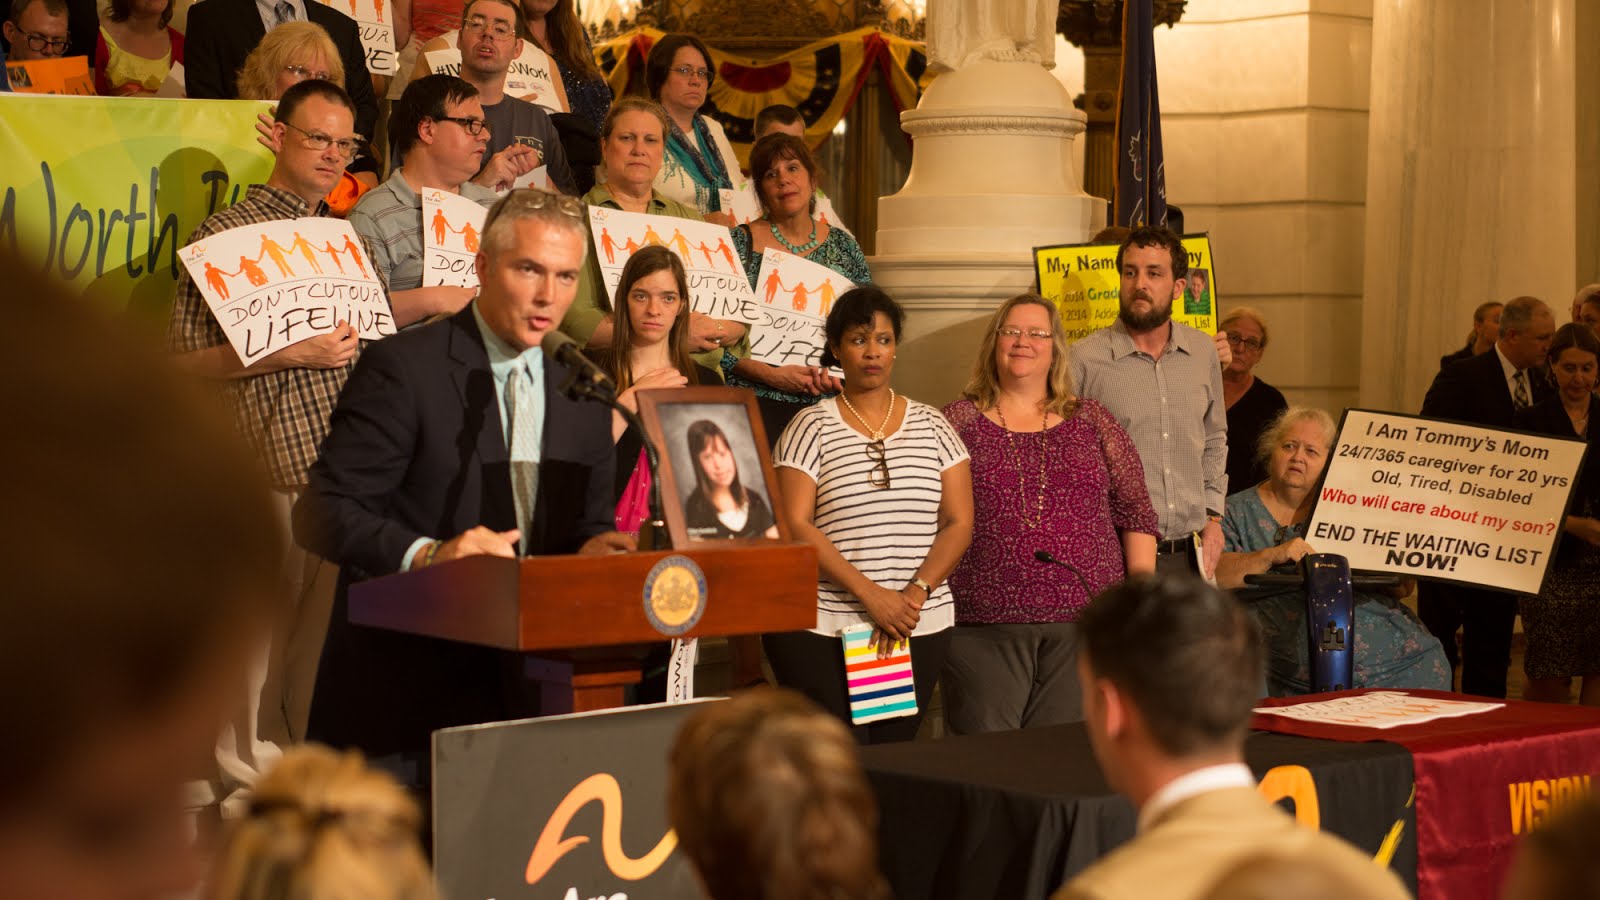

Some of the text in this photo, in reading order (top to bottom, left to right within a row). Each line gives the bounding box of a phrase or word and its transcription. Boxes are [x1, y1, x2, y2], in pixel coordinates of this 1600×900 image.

[687, 275, 750, 295] UT OUR
[1046, 256, 1070, 279] My
[1077, 254, 1117, 271] Nam
[228, 285, 307, 327] DON'T
[1087, 287, 1120, 301] Grad
[1366, 421, 1550, 461] I Am Tommy's Mom
[1339, 444, 1568, 488] 24/7/365 caregiver for 20 yrs
[1371, 470, 1533, 506] Old, Tired, Disabled
[1322, 487, 1556, 536] Who will care about my son?
[1314, 522, 1543, 566] END THE WAITING LIST
[1385, 550, 1458, 572] NOW!
